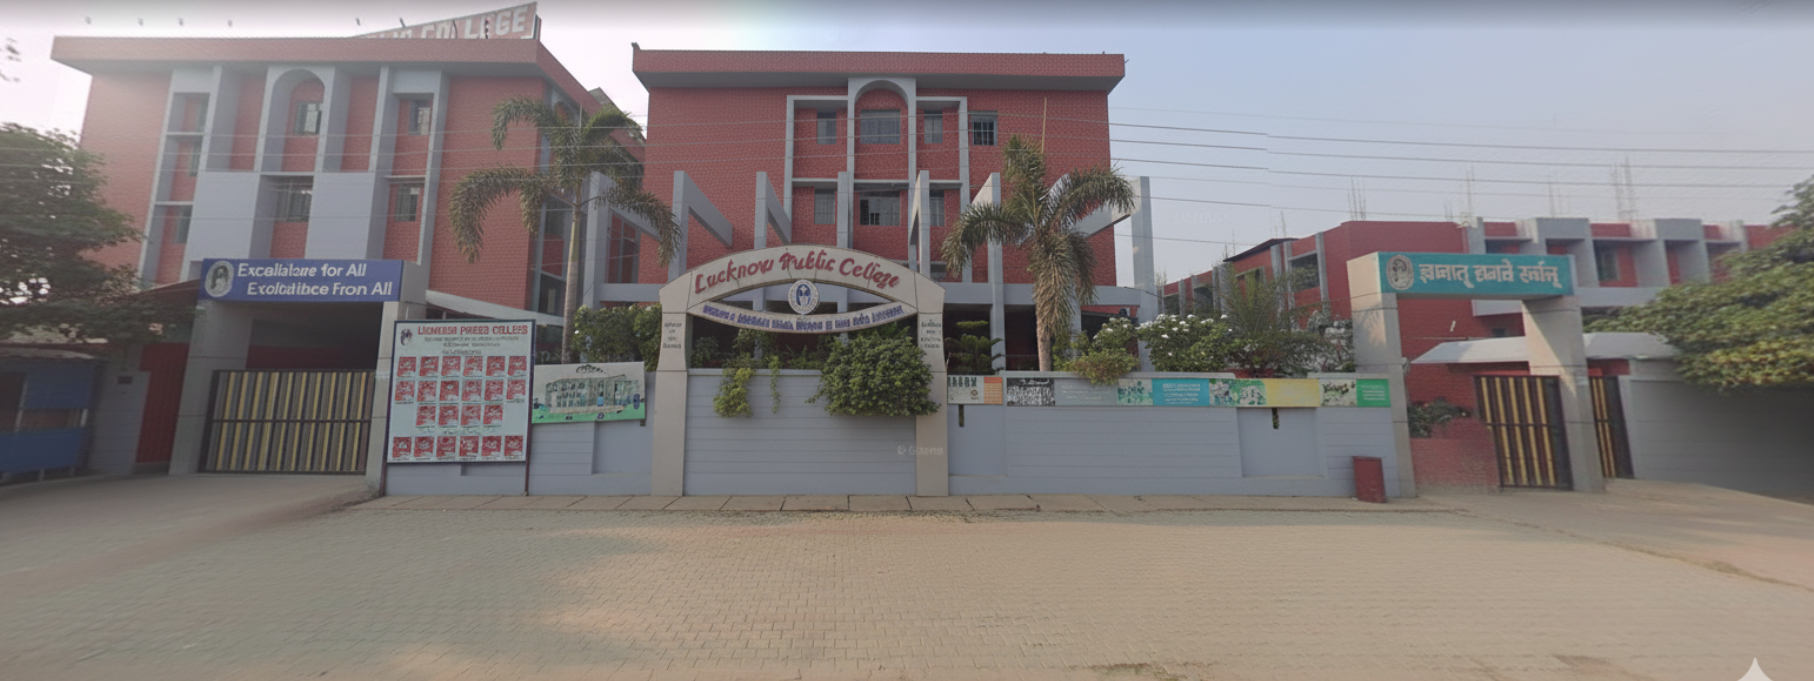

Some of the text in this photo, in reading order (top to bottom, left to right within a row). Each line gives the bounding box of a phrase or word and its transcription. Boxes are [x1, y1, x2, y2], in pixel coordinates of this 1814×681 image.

[321, 262, 344, 277] for
[345, 262, 367, 277] All
[695, 259, 774, 294] Lucknow
[370, 281, 393, 296] All
